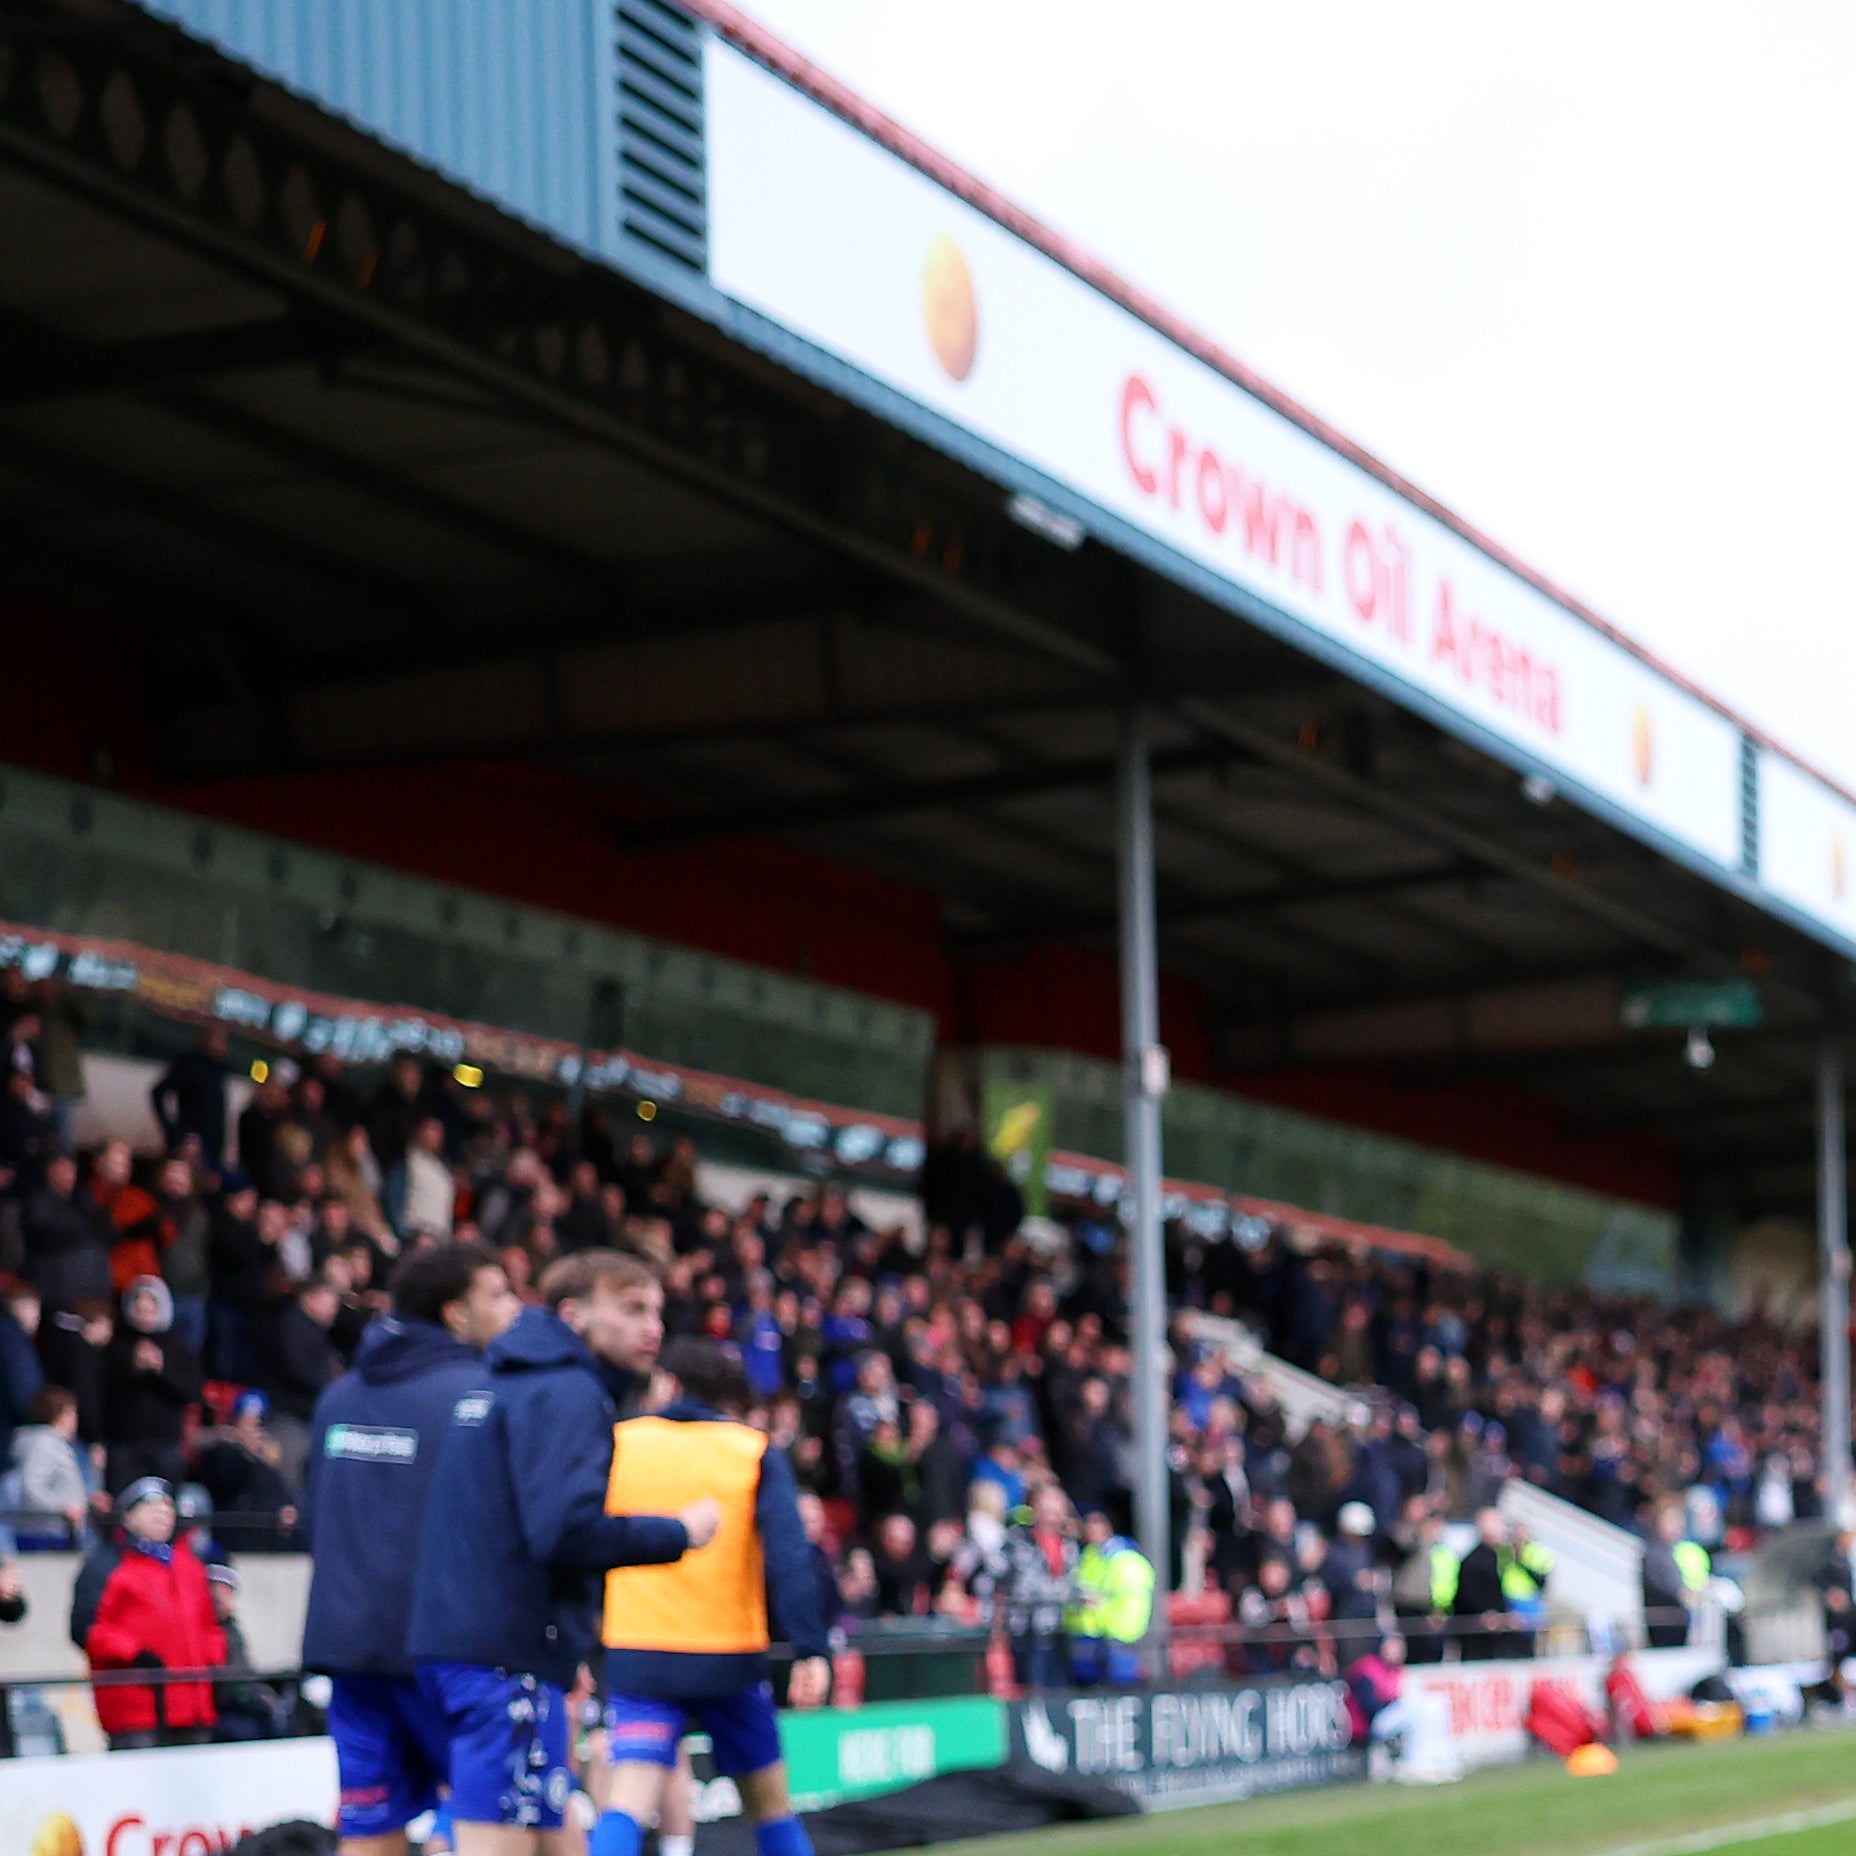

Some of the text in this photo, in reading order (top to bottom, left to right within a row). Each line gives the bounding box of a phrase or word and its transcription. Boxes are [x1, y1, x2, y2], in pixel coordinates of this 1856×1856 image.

[1117, 371, 1566, 740] Crown Oil Arena
[1066, 1694, 1144, 1775] THE
